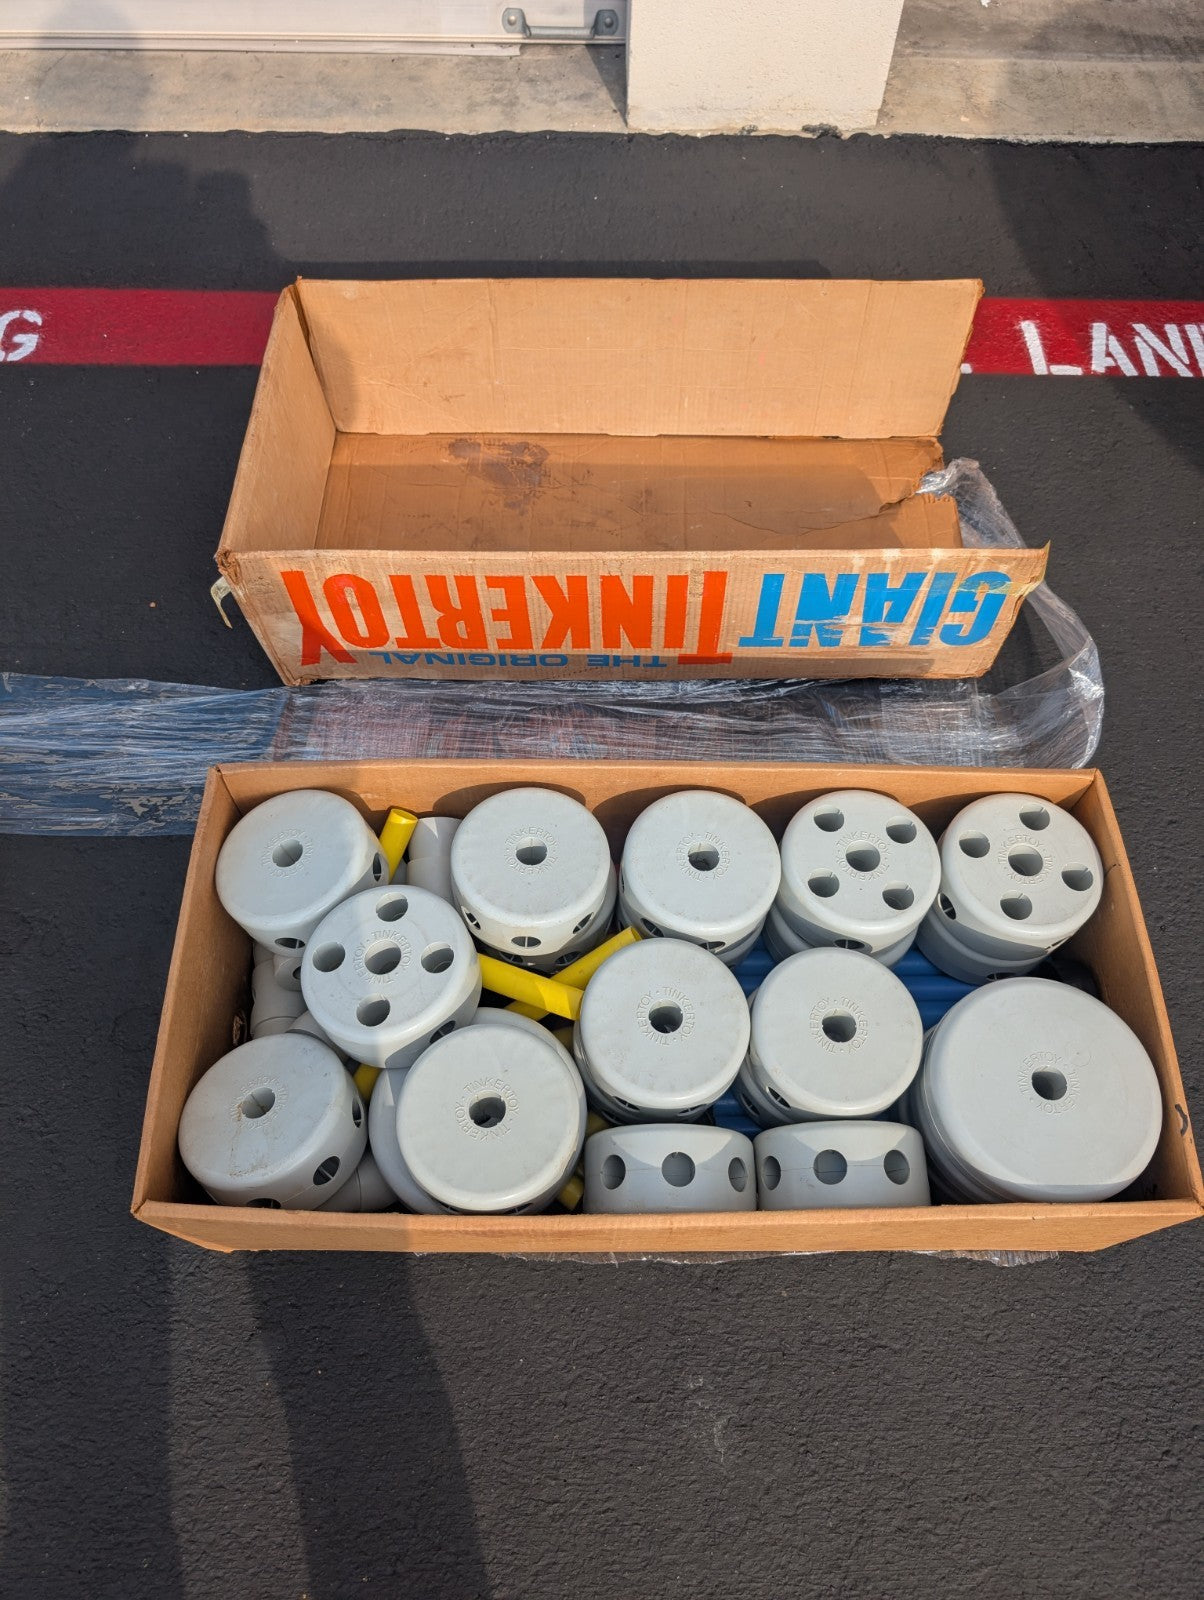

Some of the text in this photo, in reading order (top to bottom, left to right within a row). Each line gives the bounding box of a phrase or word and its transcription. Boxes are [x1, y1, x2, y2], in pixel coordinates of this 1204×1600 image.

[280, 571, 1012, 666] GIANT TINKERTOY
[369, 651, 668, 668] THE ORIGINAL
